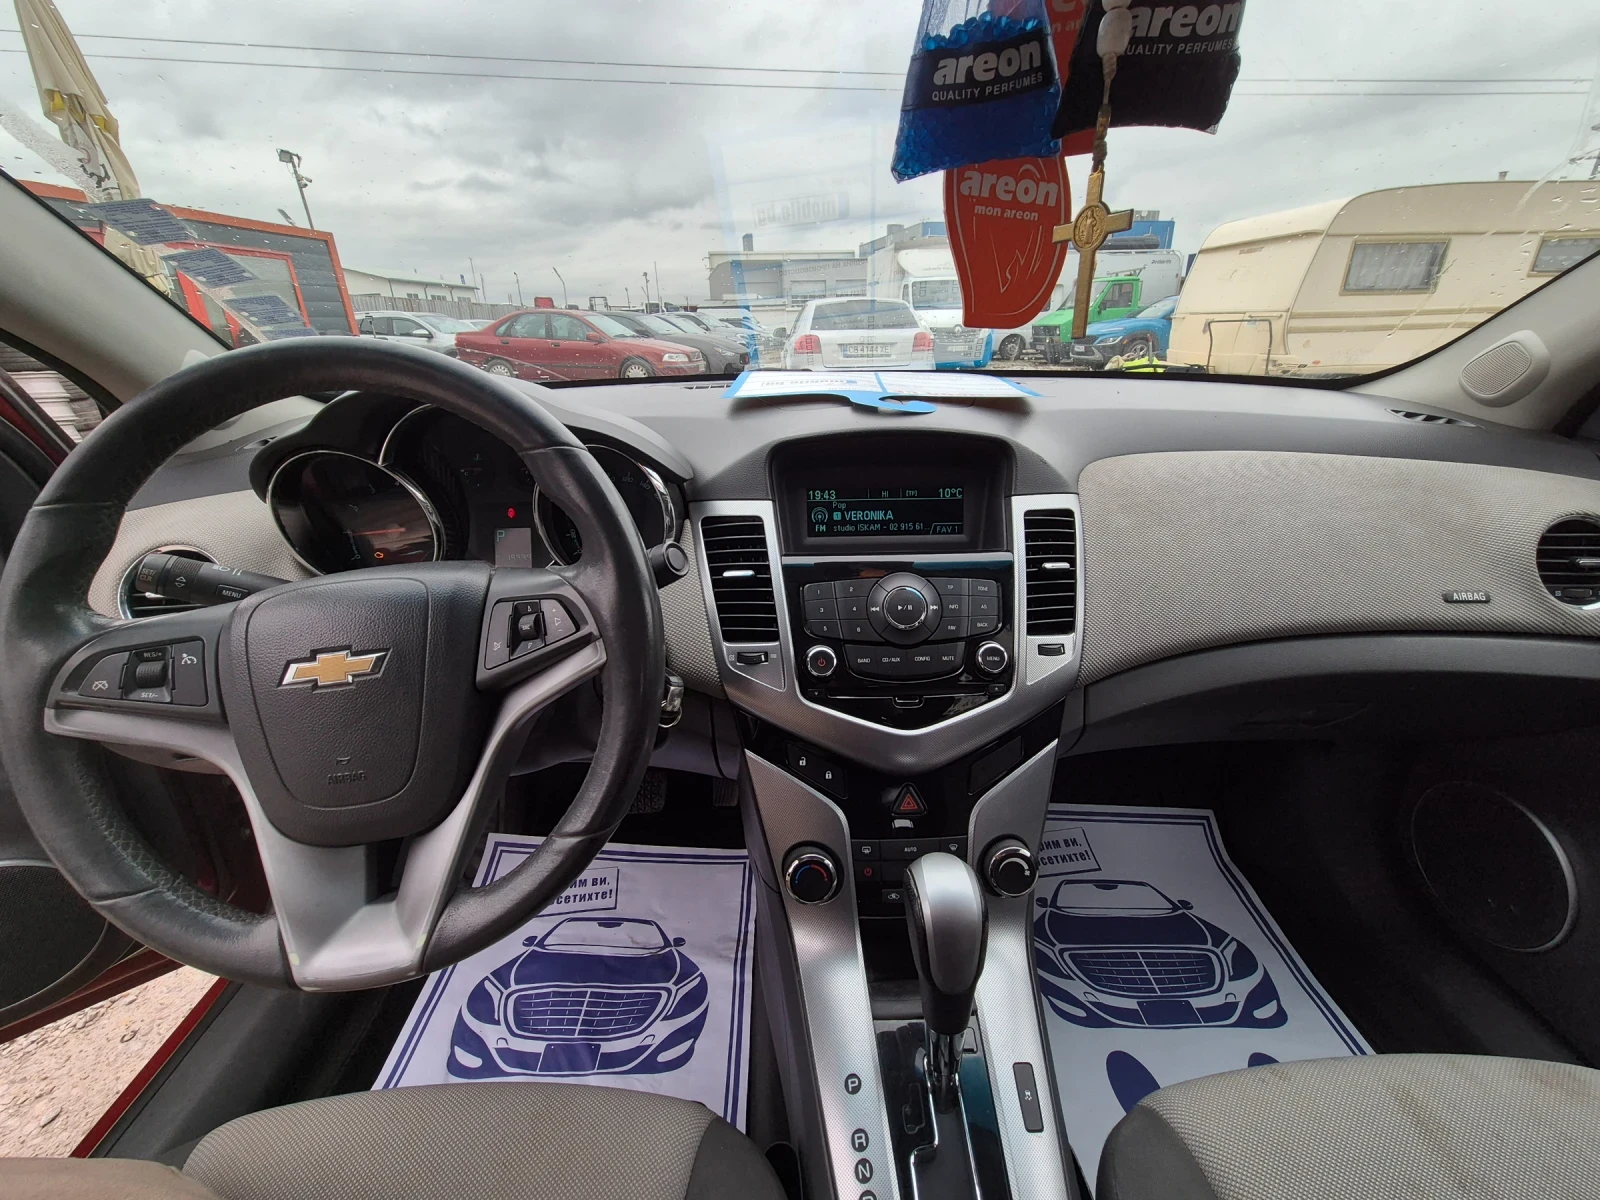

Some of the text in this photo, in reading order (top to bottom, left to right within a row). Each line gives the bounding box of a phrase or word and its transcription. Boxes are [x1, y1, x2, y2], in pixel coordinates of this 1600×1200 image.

[1130, 1, 1241, 37] areon
[1177, 38, 1233, 54] PERFUMES
[932, 39, 1042, 86] areon
[931, 72, 1043, 102] QUALITY PERFUMES
[959, 168, 1059, 207] areon
[974, 204, 1039, 222] mon areon
[880, 345, 890, 353] XE
[808, 490, 836, 500] 19:43
[938, 488, 963, 498] 10°C
[832, 501, 847, 510] Pop
[844, 510, 894, 521] VERONIKA
[815, 524, 826, 532] FM
[833, 524, 856, 532] studio
[857, 523, 880, 532] ISKAM
[889, 523, 898, 531] 02
[900, 523, 914, 531] 915
[937, 525, 952, 534] FAV
[497, 530, 505, 542] P
[221, 589, 242, 599] MENU
[1453, 592, 1486, 601] AIRBAG
[327, 771, 367, 785] AIRBAG
[1063, 837, 1082, 848] ви,
[591, 877, 610, 887] ви,
[552, 889, 613, 905] сетихте!
[848, 1078, 858, 1091] P
[855, 1134, 866, 1147] R
[859, 1164, 870, 1178] N
